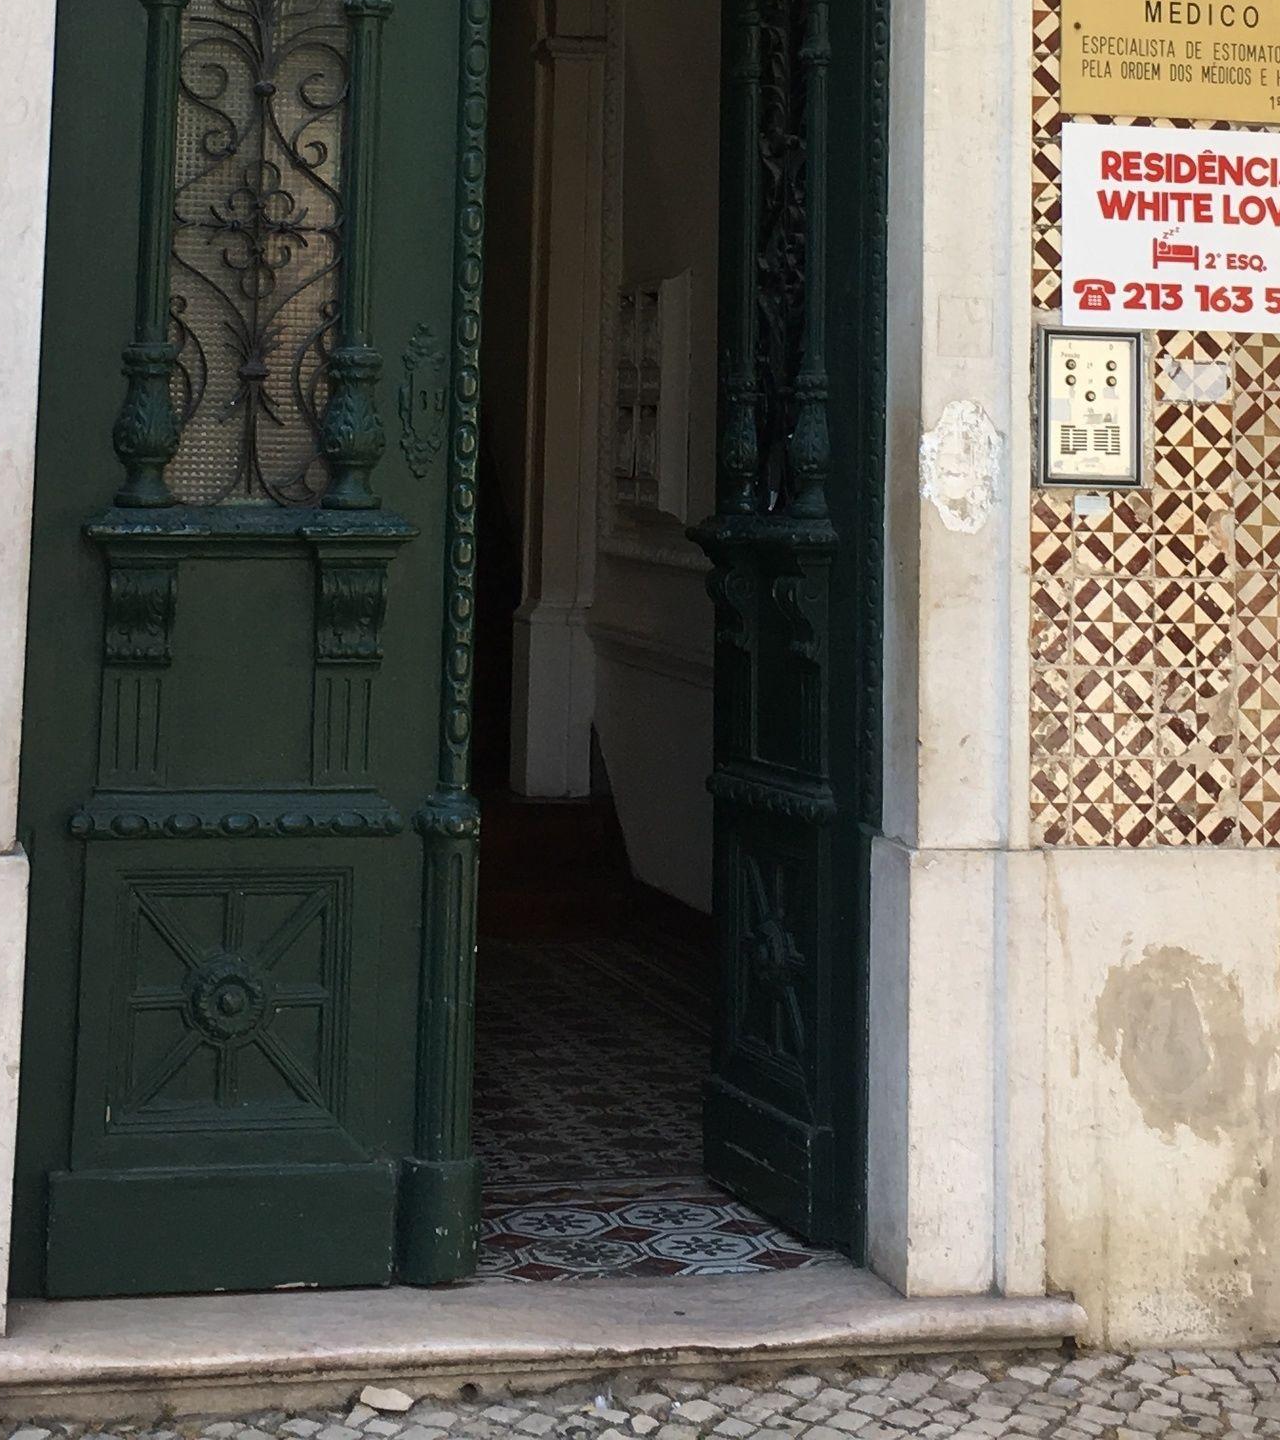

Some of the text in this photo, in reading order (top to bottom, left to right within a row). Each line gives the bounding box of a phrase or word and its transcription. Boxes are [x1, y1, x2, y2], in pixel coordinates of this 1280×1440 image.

[1082, 35, 1176, 58] ESPECIALISTA
[1186, 40, 1203, 60] DE
[1082, 59, 1112, 78] PELA
[1121, 60, 1161, 81] ORDEM
[1170, 63, 1193, 83] DOS
[1201, 62, 1252, 85] MÉDICOS
[1261, 68, 1267, 86] E
[1096, 189, 1213, 223] WHITE
[1226, 253, 1268, 273] ESQ.
[1123, 282, 1184, 311] 213
[1194, 284, 1254, 314] 163
